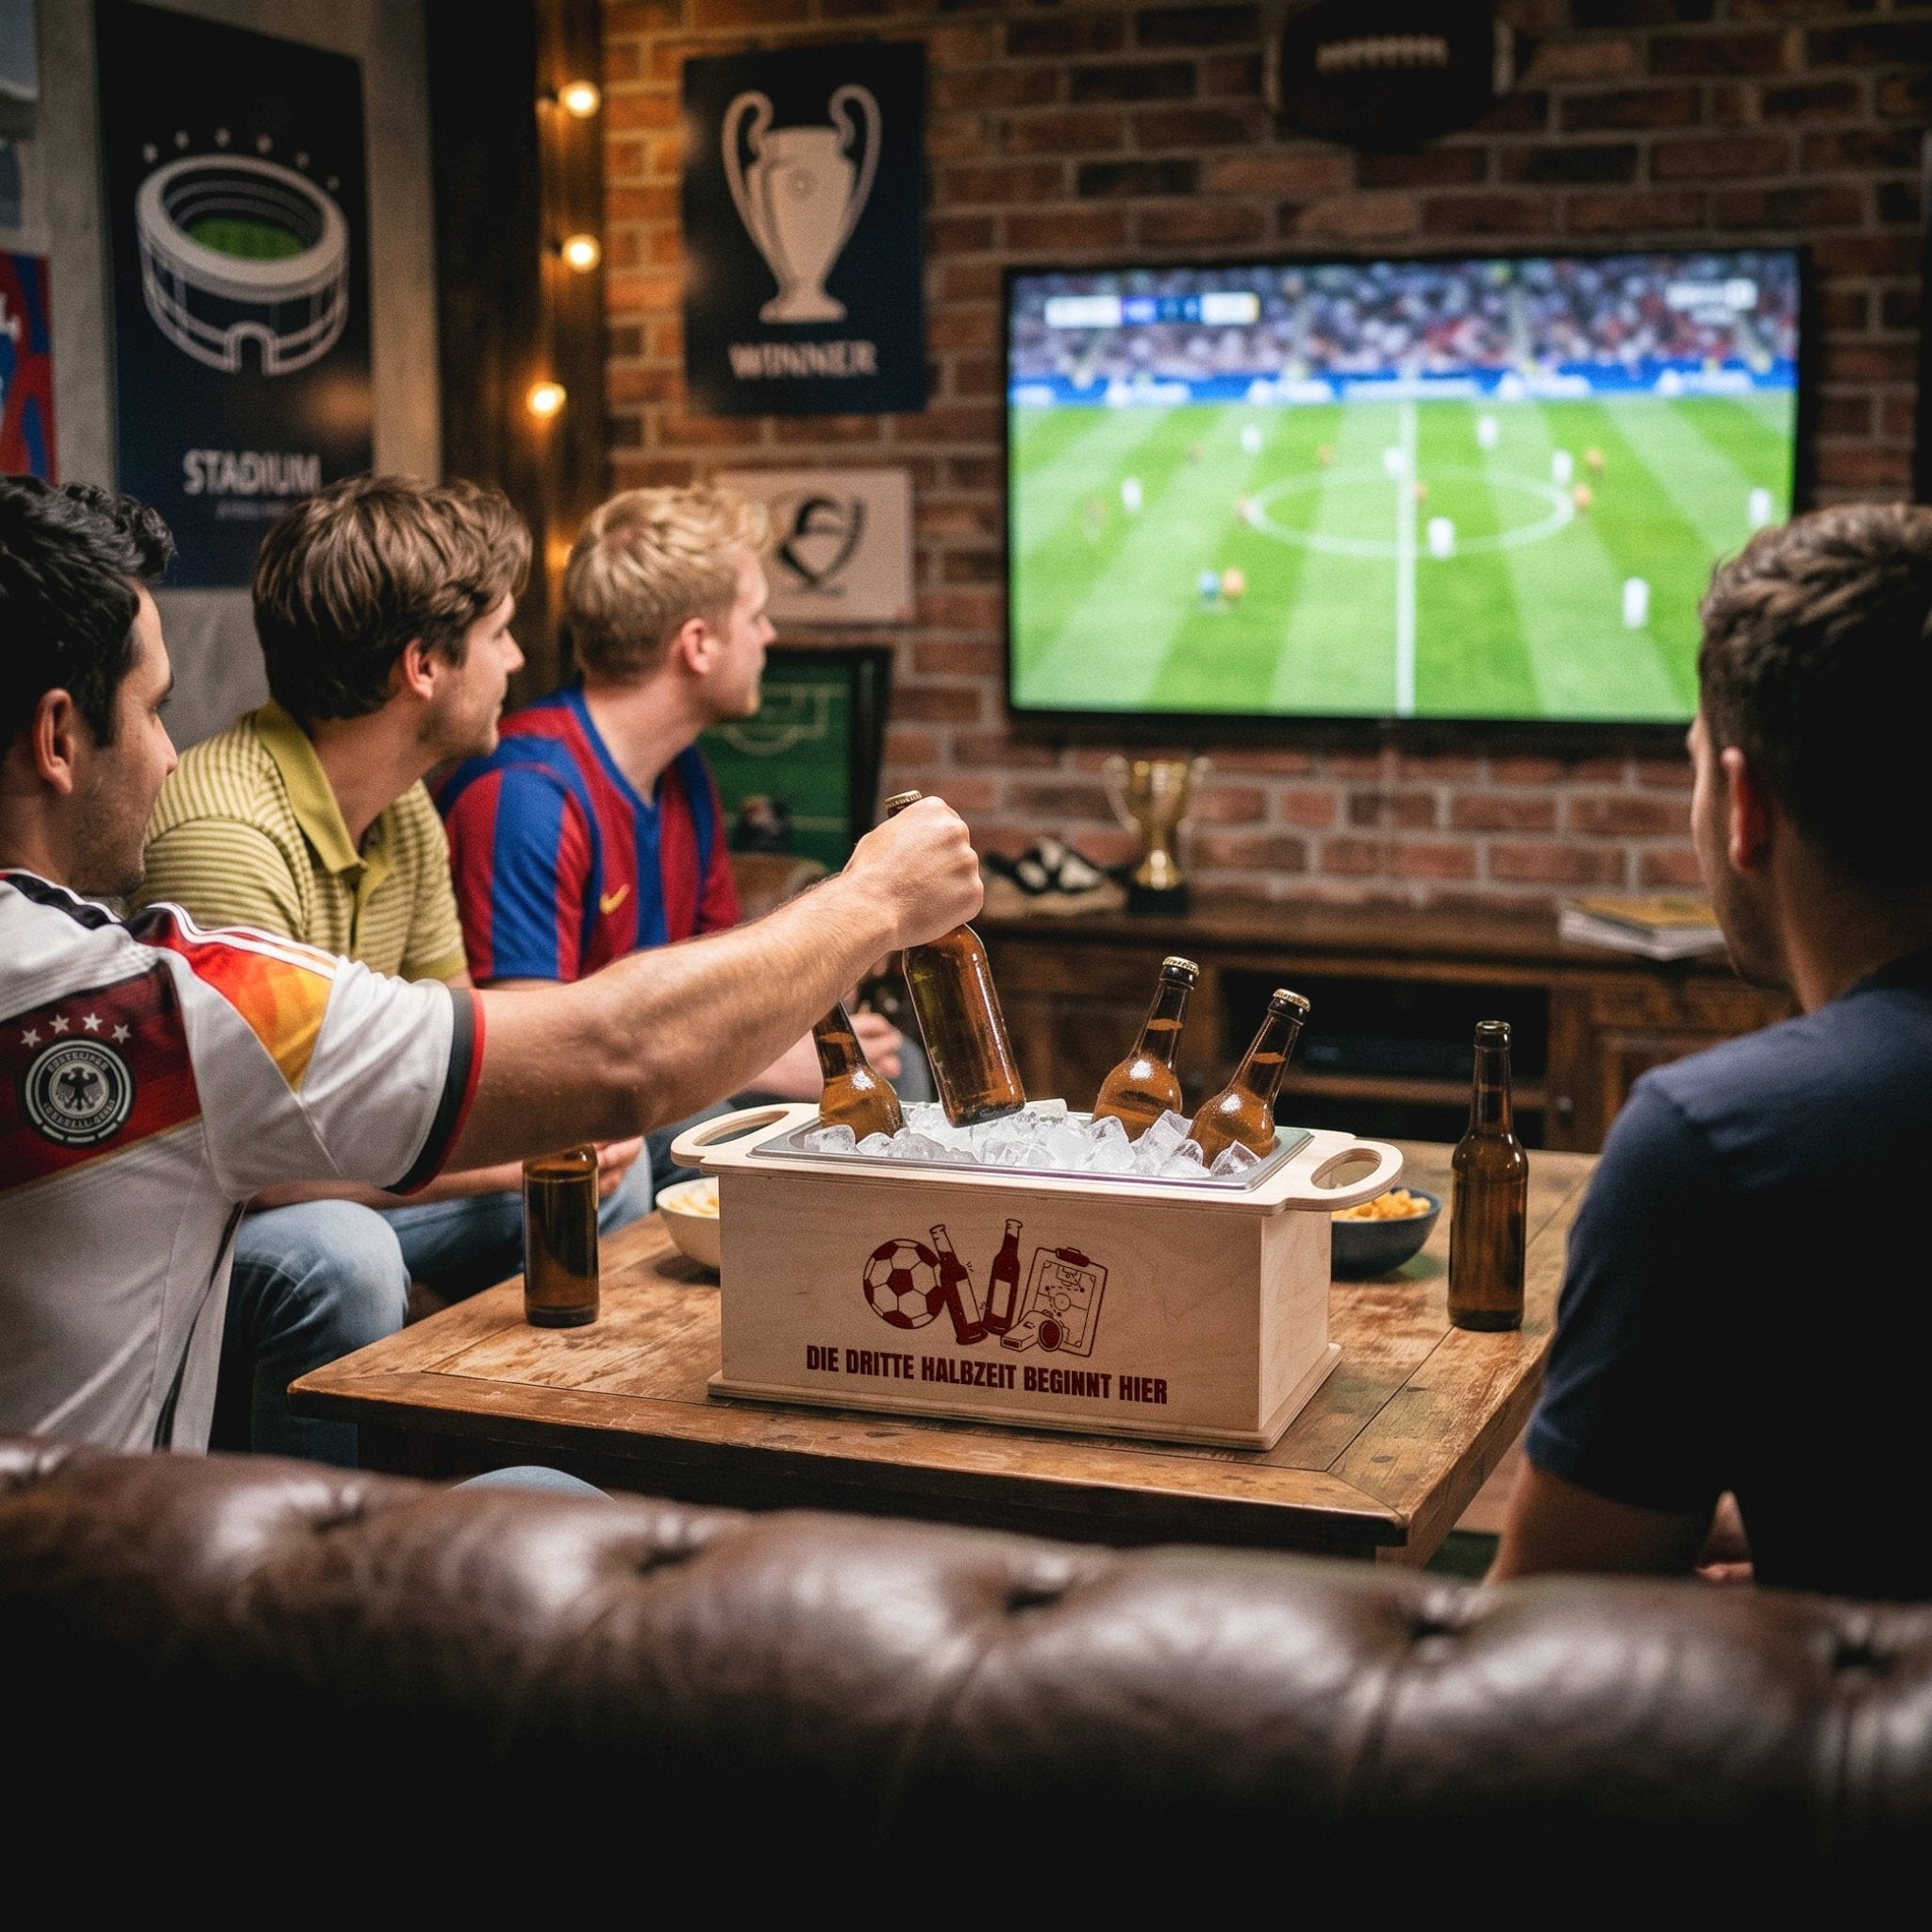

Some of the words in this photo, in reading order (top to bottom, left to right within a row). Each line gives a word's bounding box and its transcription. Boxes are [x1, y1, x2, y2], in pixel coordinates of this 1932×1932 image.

[728, 340, 878, 378] WINNER
[183, 449, 321, 494] STADIUM
[807, 1344, 839, 1373] DIE
[846, 1349, 914, 1380] DRITTE
[922, 1356, 1016, 1390] HALBZEIT
[1024, 1365, 1112, 1399] BEGINNT
[1119, 1375, 1168, 1405] HIER
